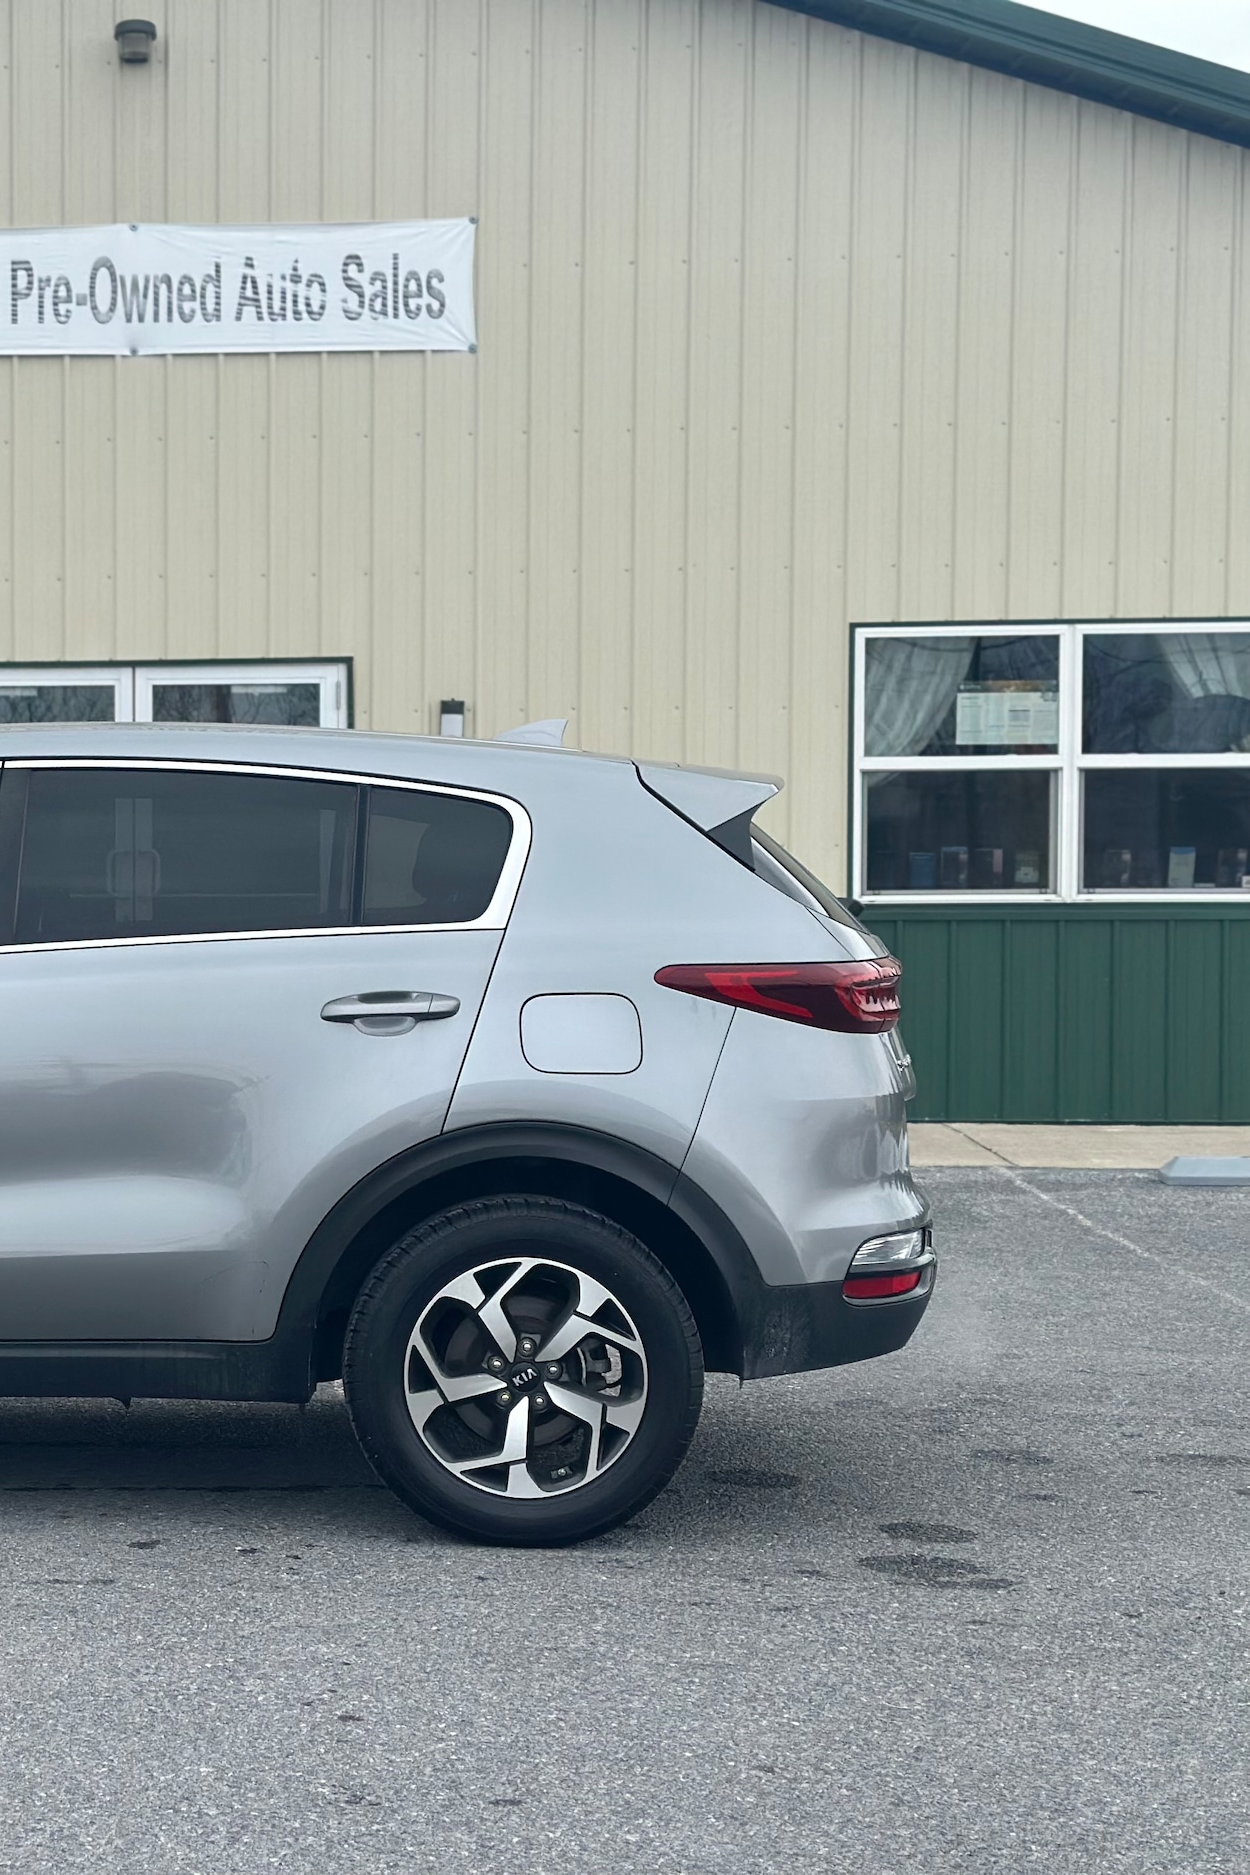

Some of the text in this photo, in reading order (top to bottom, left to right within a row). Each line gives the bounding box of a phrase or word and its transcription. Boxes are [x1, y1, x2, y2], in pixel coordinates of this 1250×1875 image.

[10, 255, 222, 325] Pre-Owned
[234, 255, 327, 322] Auto
[341, 251, 447, 322] Sales
[512, 1369, 537, 1386] KIA
